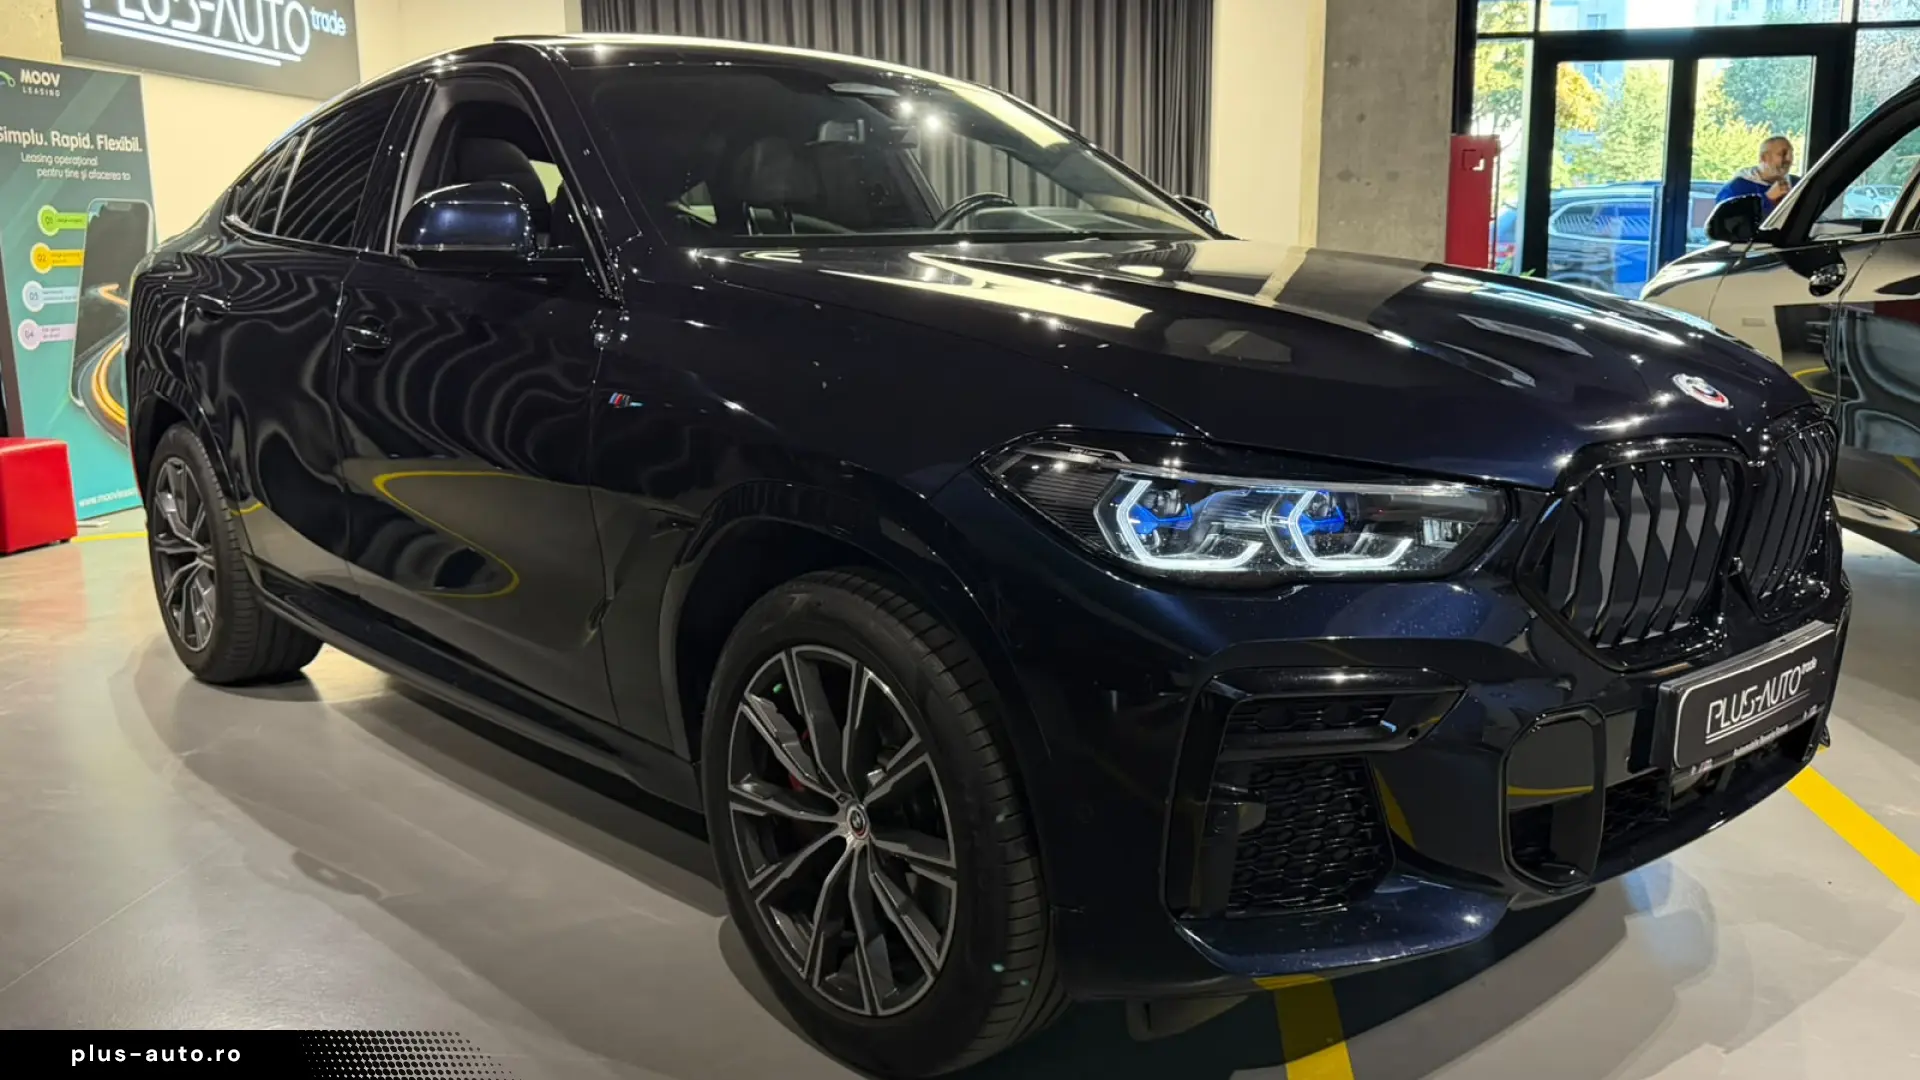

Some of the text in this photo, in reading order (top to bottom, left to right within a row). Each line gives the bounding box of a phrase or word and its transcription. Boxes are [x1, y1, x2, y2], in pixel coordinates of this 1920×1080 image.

[310, 7, 347, 37] trade
[20, 68, 61, 88] MOOV
[22, 86, 61, 98] LEASING
[51, 130, 95, 152] Rapid.
[96, 134, 143, 153] Flexibil.
[21, 151, 54, 166] Leasing
[36, 167, 64, 180] pentru
[1706, 666, 1801, 734] PLUS-AUTO
